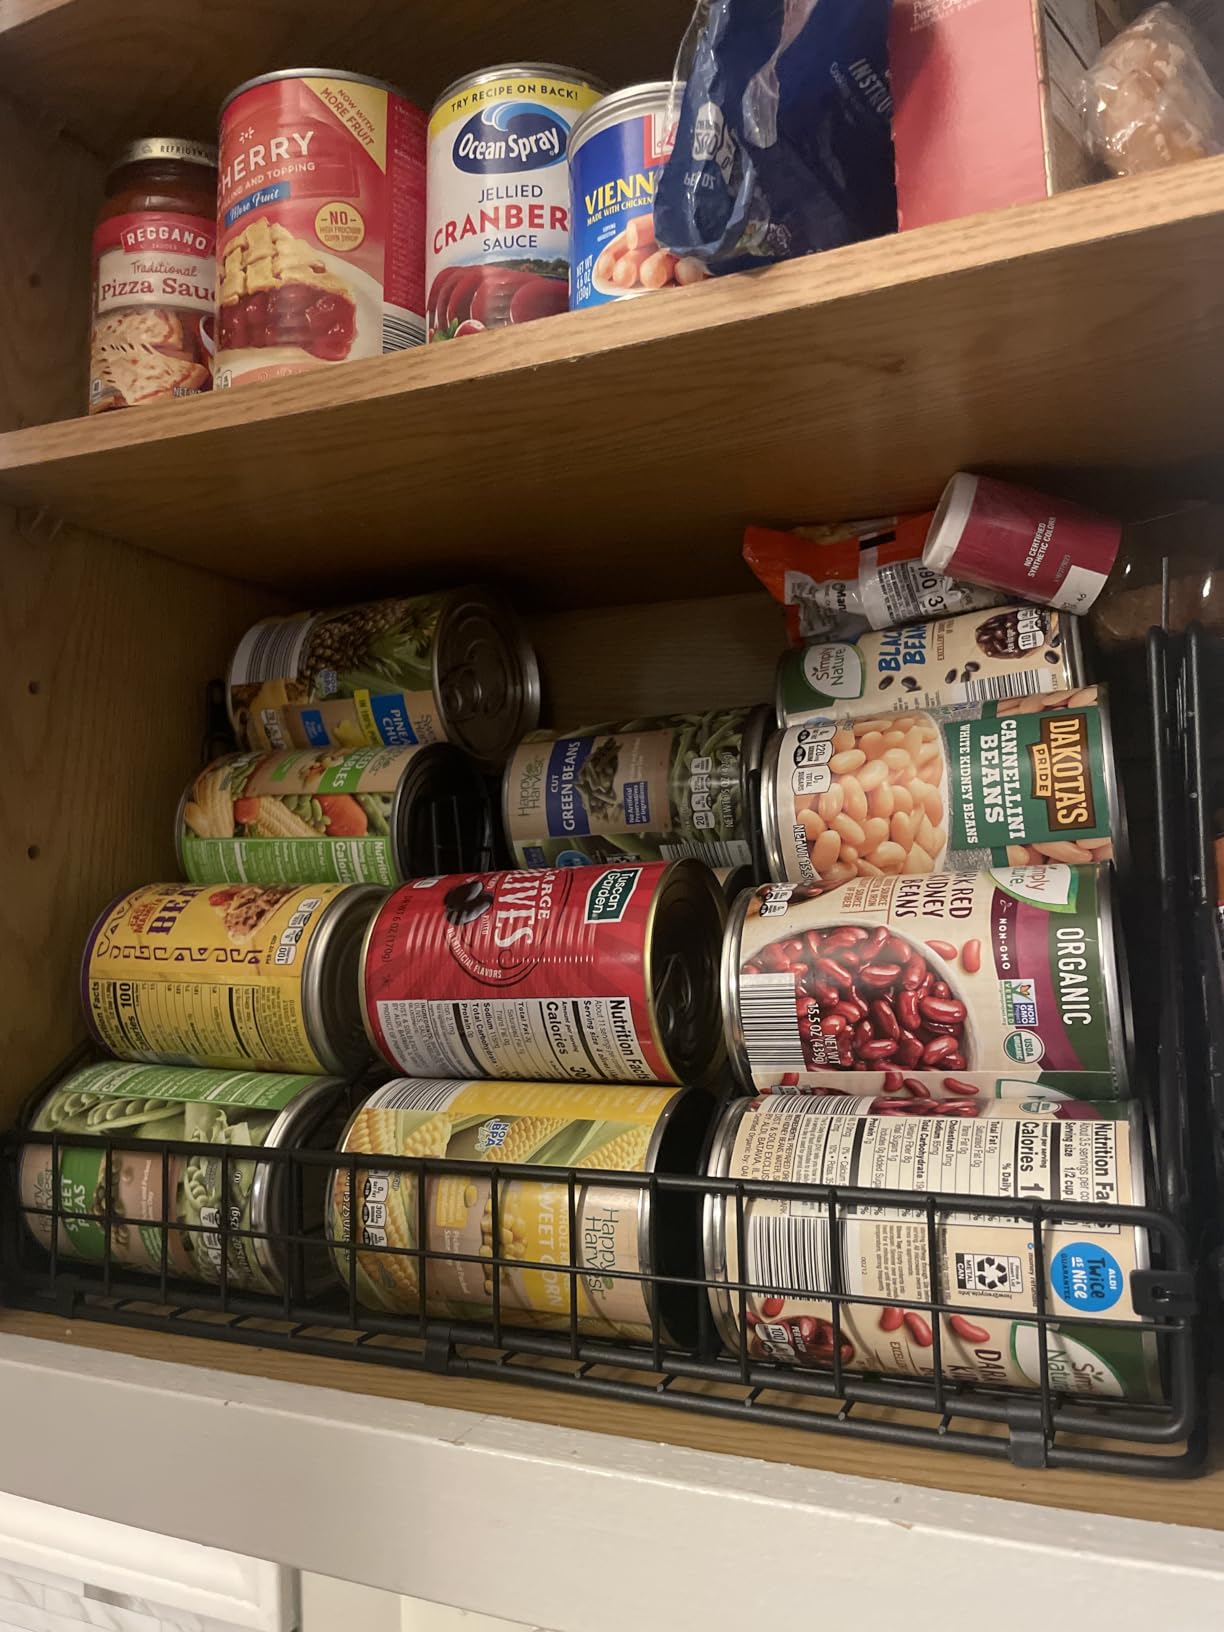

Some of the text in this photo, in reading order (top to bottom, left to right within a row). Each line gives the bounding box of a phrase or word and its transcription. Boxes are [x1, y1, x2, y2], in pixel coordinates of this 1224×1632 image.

[337, 89, 375, 132] NOW WITH
[451, 84, 578, 112] TRY RECIPE ON BACK!
[320, 87, 375, 146] MORE FRUIT
[458, 127, 560, 162] Ocean Spray
[222, 131, 314, 194] HERRY
[245, 162, 316, 189] AND TOPPING
[252, 188, 280, 207] Fruit
[478, 184, 543, 204] JELLIED
[585, 171, 654, 215] VIENN
[329, 210, 348, 225] NO
[587, 197, 654, 226] MADE WITH CHICKEN
[126, 227, 207, 250] REGGANO
[483, 235, 538, 252] SAUCE
[131, 259, 199, 277] Traditional
[101, 279, 154, 301] Pizza
[1024, 522, 1046, 567] NO CERTIFIED
[1027, 542, 1049, 578] SYNTHETIC
[1021, 634, 1032, 648] 110
[816, 648, 835, 681] Simply
[831, 647, 846, 686] Nature
[551, 774, 560, 793] CUT
[561, 741, 581, 831] GREEN BEANS
[959, 724, 978, 844] WHITE KIDNEY BEANS
[980, 733, 1004, 823] BEANS
[1000, 719, 1026, 839] CANNELLINI
[1035, 748, 1049, 793] PRIDE
[1050, 718, 1088, 824] DAKOTA'S
[517, 772, 530, 817] Happy
[625, 787, 634, 815] Artificial
[695, 815, 706, 826] 20
[793, 824, 809, 859] NET WT
[592, 872, 618, 914] Garden
[606, 871, 635, 911] Tuscan
[895, 878, 924, 919] BEANS
[949, 886, 975, 919] RED
[276, 947, 288, 962] 100
[999, 917, 1011, 971] NON-GMO
[473, 965, 502, 979] FLAVORS
[1056, 927, 1092, 1025] ORGANIC
[92, 981, 101, 1010] Facts
[119, 983, 132, 1009] 100
[1003, 980, 1014, 1025] VERIFIED
[461, 1003, 471, 1030] Protein
[472, 1003, 482, 1022] Total
[483, 1003, 494, 1030] Sodium
[517, 1002, 531, 1036] Total Fat
[546, 1001, 569, 1055] Calories
[584, 1000, 600, 1046] Serving size
[1021, 1004, 1029, 1025] GMO
[1027, 1003, 1035, 1025] NON
[609, 1000, 651, 1080] Nutrition Facts
[807, 1003, 828, 1065] 15.5 OZ (439g)
[824, 1034, 841, 1065] NET WT
[1013, 1035, 1024, 1060] ORGANIC
[1023, 1038, 1034, 1058] USDA
[485, 1123, 501, 1147] BPA
[495, 1123, 509, 1146] NON
[768, 1132, 777, 1150] SOLD
[866, 1118, 879, 1137] Protein
[932, 1120, 945, 1140] Sodium
[942, 1120, 959, 1167] Cholesterol 0mg
[961, 1138, 970, 1147] Fat
[986, 1121, 1000, 1154] Total Fat 0g
[889, 1137, 901, 1153] Sugars
[905, 1141, 914, 1155] Fiber
[916, 1119, 932, 1179] Total Carbohydrate
[1019, 1121, 1040, 1172] Calories
[1039, 1149, 1048, 1168] serving
[1062, 1122, 1077, 1196] Serving size 1/2 cup
[1094, 1123, 1114, 1177] Nutrition
[875, 1154, 885, 1171] Added
[1000, 1162, 1012, 1193] % Daily
[1077, 1138, 1090, 1190] 3.5 servings per
[599, 1207, 619, 1274] Happy
[965, 1259, 973, 1284] METAL
[1061, 1253, 1071, 1300] GUARANTEE
[1071, 1256, 1088, 1300] as Nice
[1087, 1257, 1106, 1299] Twice
[1108, 1267, 1117, 1290] ALDI
[770, 1327, 786, 1342] 100
